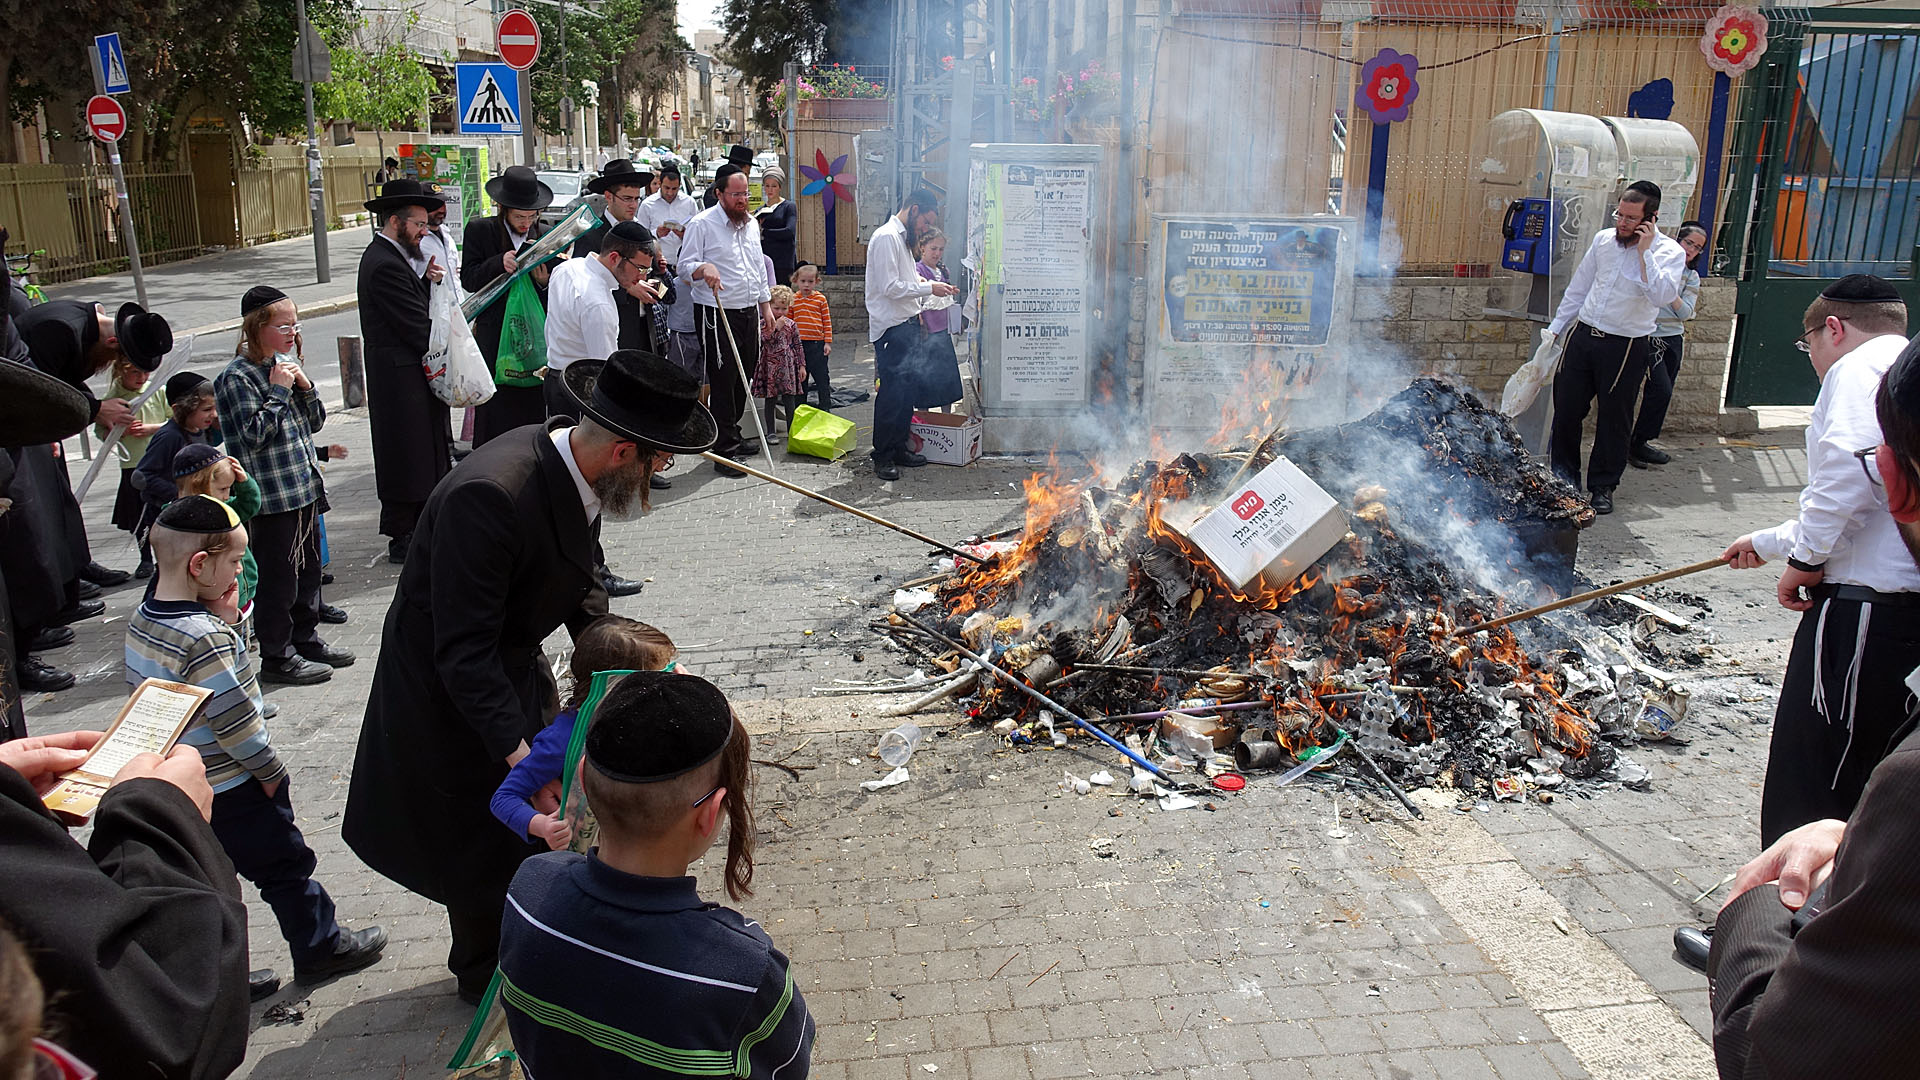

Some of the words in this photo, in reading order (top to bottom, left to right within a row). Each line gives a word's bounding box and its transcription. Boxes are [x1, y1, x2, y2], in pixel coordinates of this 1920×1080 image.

[1180, 229, 1205, 239] חינם
[1208, 230, 1240, 240] הסעה
[1245, 232, 1277, 246] מוקדי
[1191, 243, 1221, 254] הענק
[1224, 242, 1264, 254] למעמד
[1186, 256, 1207, 266] טדי
[1210, 257, 1267, 268] באיצטדיון
[1194, 270, 1231, 289] אילן
[1237, 274, 1258, 288] בר
[1263, 275, 1308, 289] צומת
[1040, 288, 1064, 296] הכנסת
[1066, 288, 1080, 296] בית
[1195, 298, 1251, 312] האומה
[1256, 300, 1302, 315] בנייני
[1006, 325, 1022, 339] לוין
[1025, 325, 1037, 337] דב
[1040, 325, 1069, 337] אברהם
[1262, 323, 1282, 331] 15:00
[915, 428, 939, 437] מובחר
[927, 437, 949, 454] דניאל
[940, 432, 954, 448] בצל
[1238, 496, 1258, 515] מיה
[1269, 493, 1287, 511] שמן
[1249, 508, 1270, 526] אגוזי
[1274, 504, 1289, 518] ליטר
[1232, 525, 1250, 542] מלך
[1259, 522, 1269, 531] 15
[1240, 530, 1259, 548] יחידות
